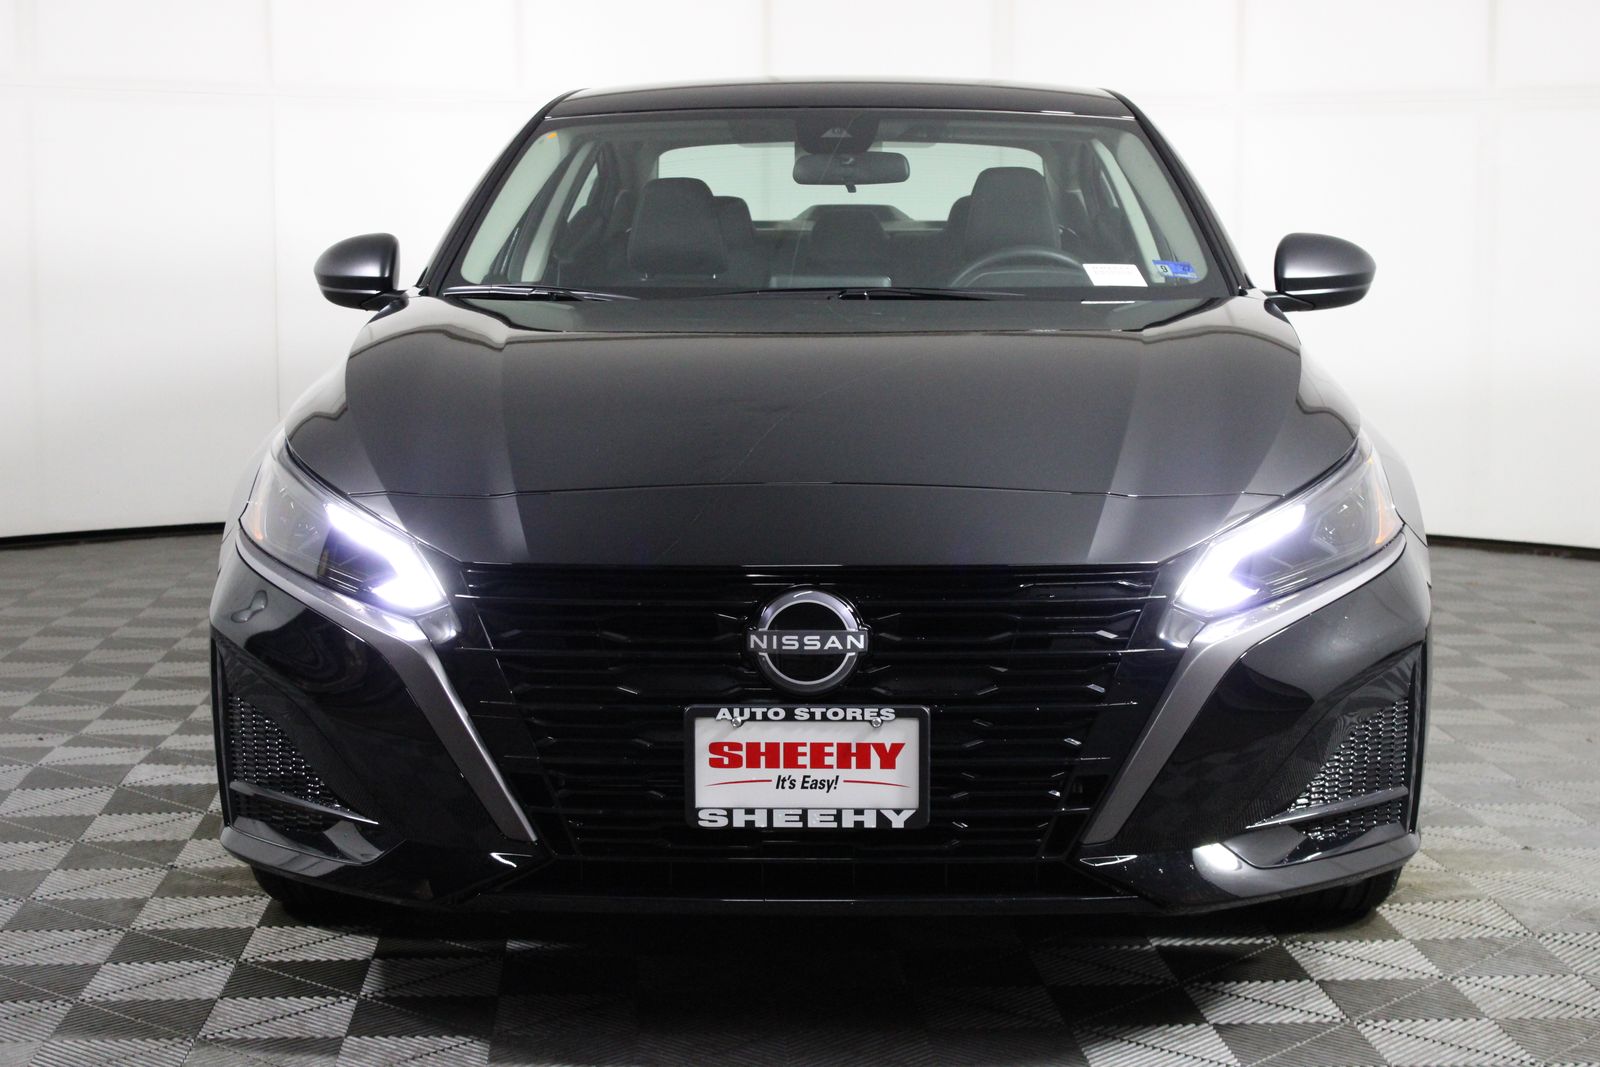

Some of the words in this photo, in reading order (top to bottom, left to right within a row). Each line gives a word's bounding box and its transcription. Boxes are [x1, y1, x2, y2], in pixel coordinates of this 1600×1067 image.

[750, 634, 865, 650] NISSAN
[716, 708, 786, 721] AUTO
[794, 708, 896, 721] STORES
[708, 741, 906, 770] SHEEHY
[775, 775, 796, 790] It's
[800, 775, 839, 793] Easy!
[697, 808, 917, 828] SHEEHY
